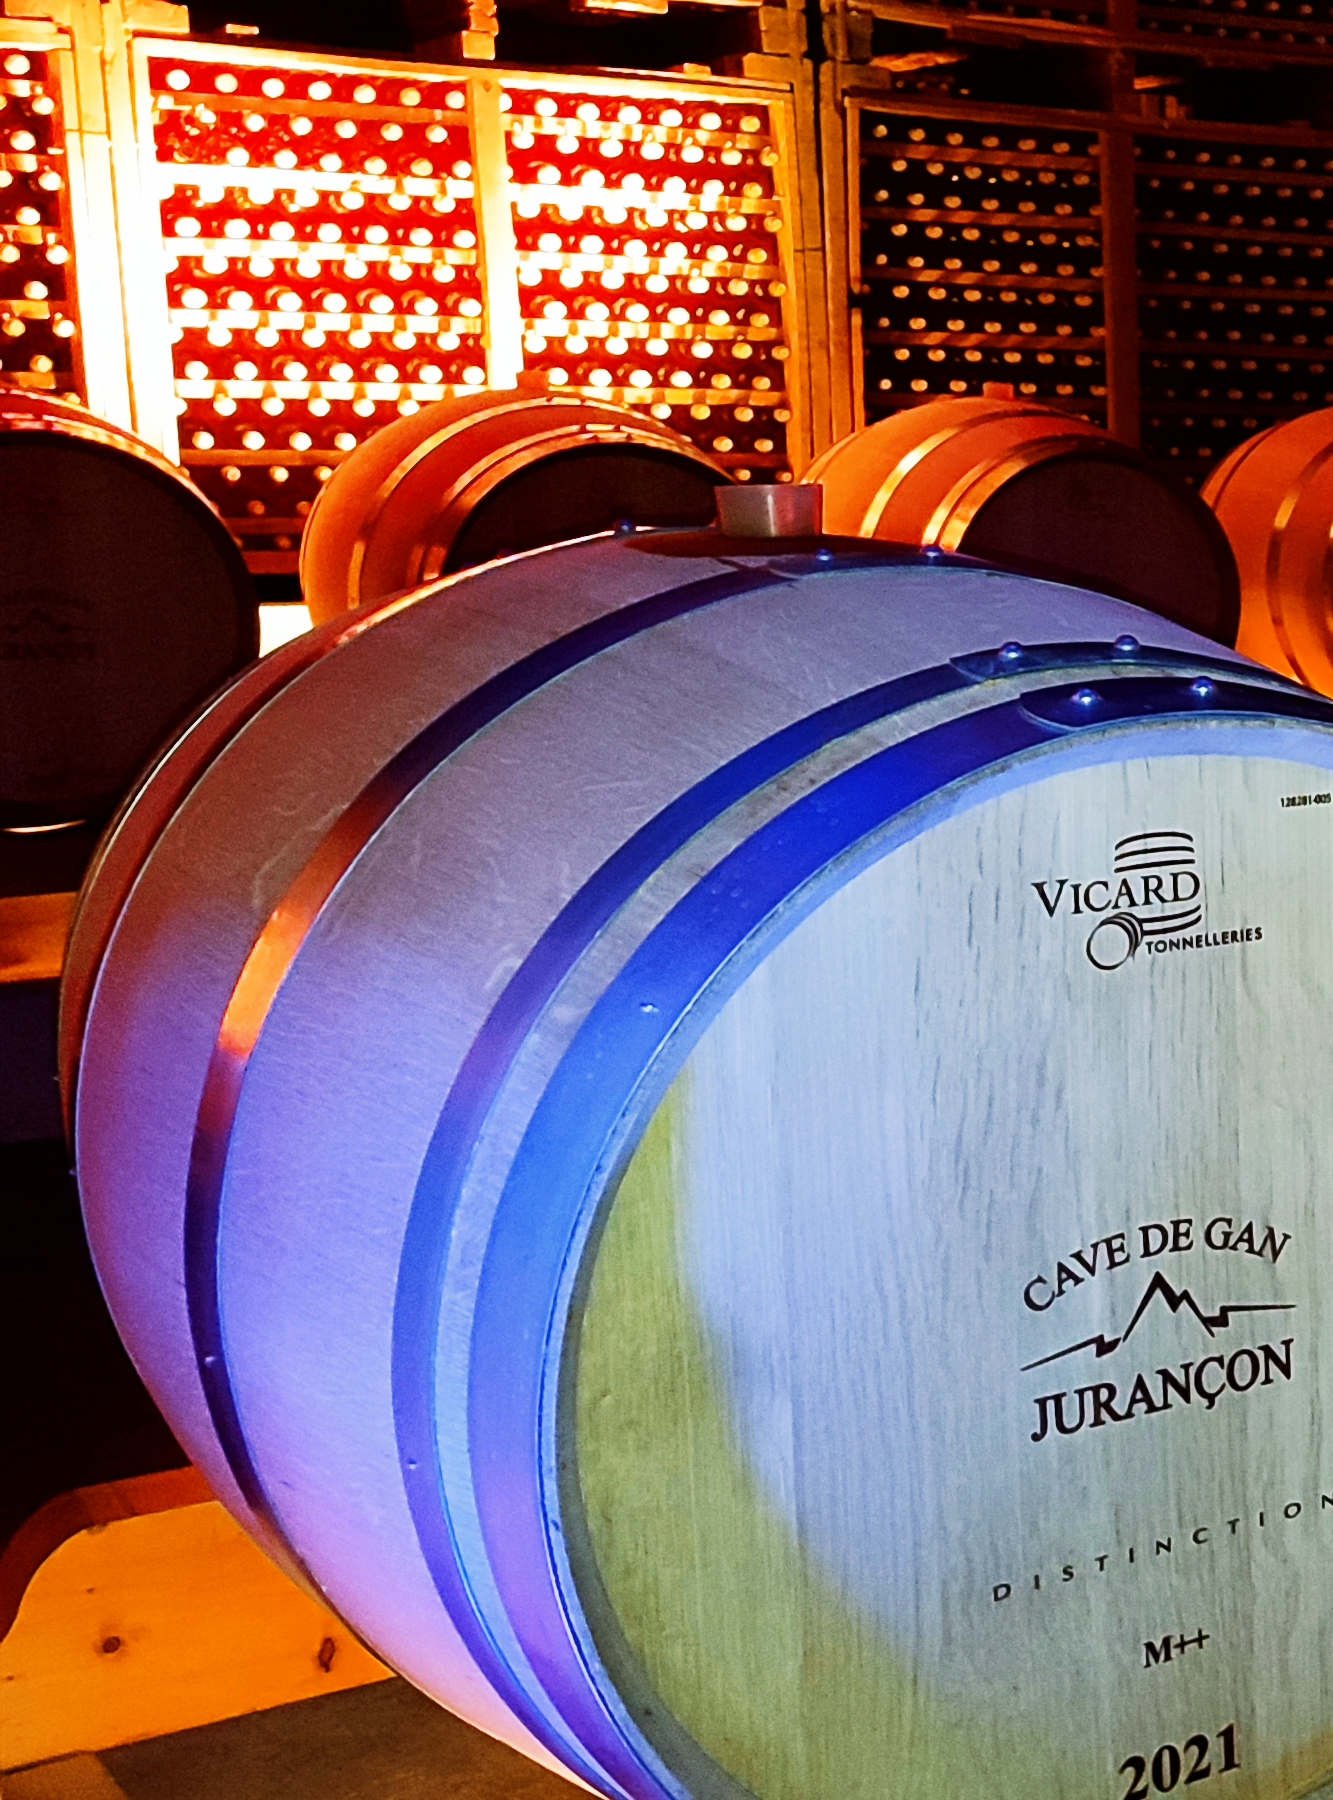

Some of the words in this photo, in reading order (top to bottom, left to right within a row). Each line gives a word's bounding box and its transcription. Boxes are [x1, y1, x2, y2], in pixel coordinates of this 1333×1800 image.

[1031, 871, 1201, 917] VICARD
[1145, 926, 1263, 955] TONNELLERIES
[1023, 1232, 1131, 1312] CAVE
[1138, 1218, 1194, 1259] DE
[1204, 1217, 1292, 1264] GAN
[1030, 1338, 1294, 1442] JURANÇON
[1143, 1628, 1210, 1668] M++
[1118, 1722, 1242, 1800] 2021
